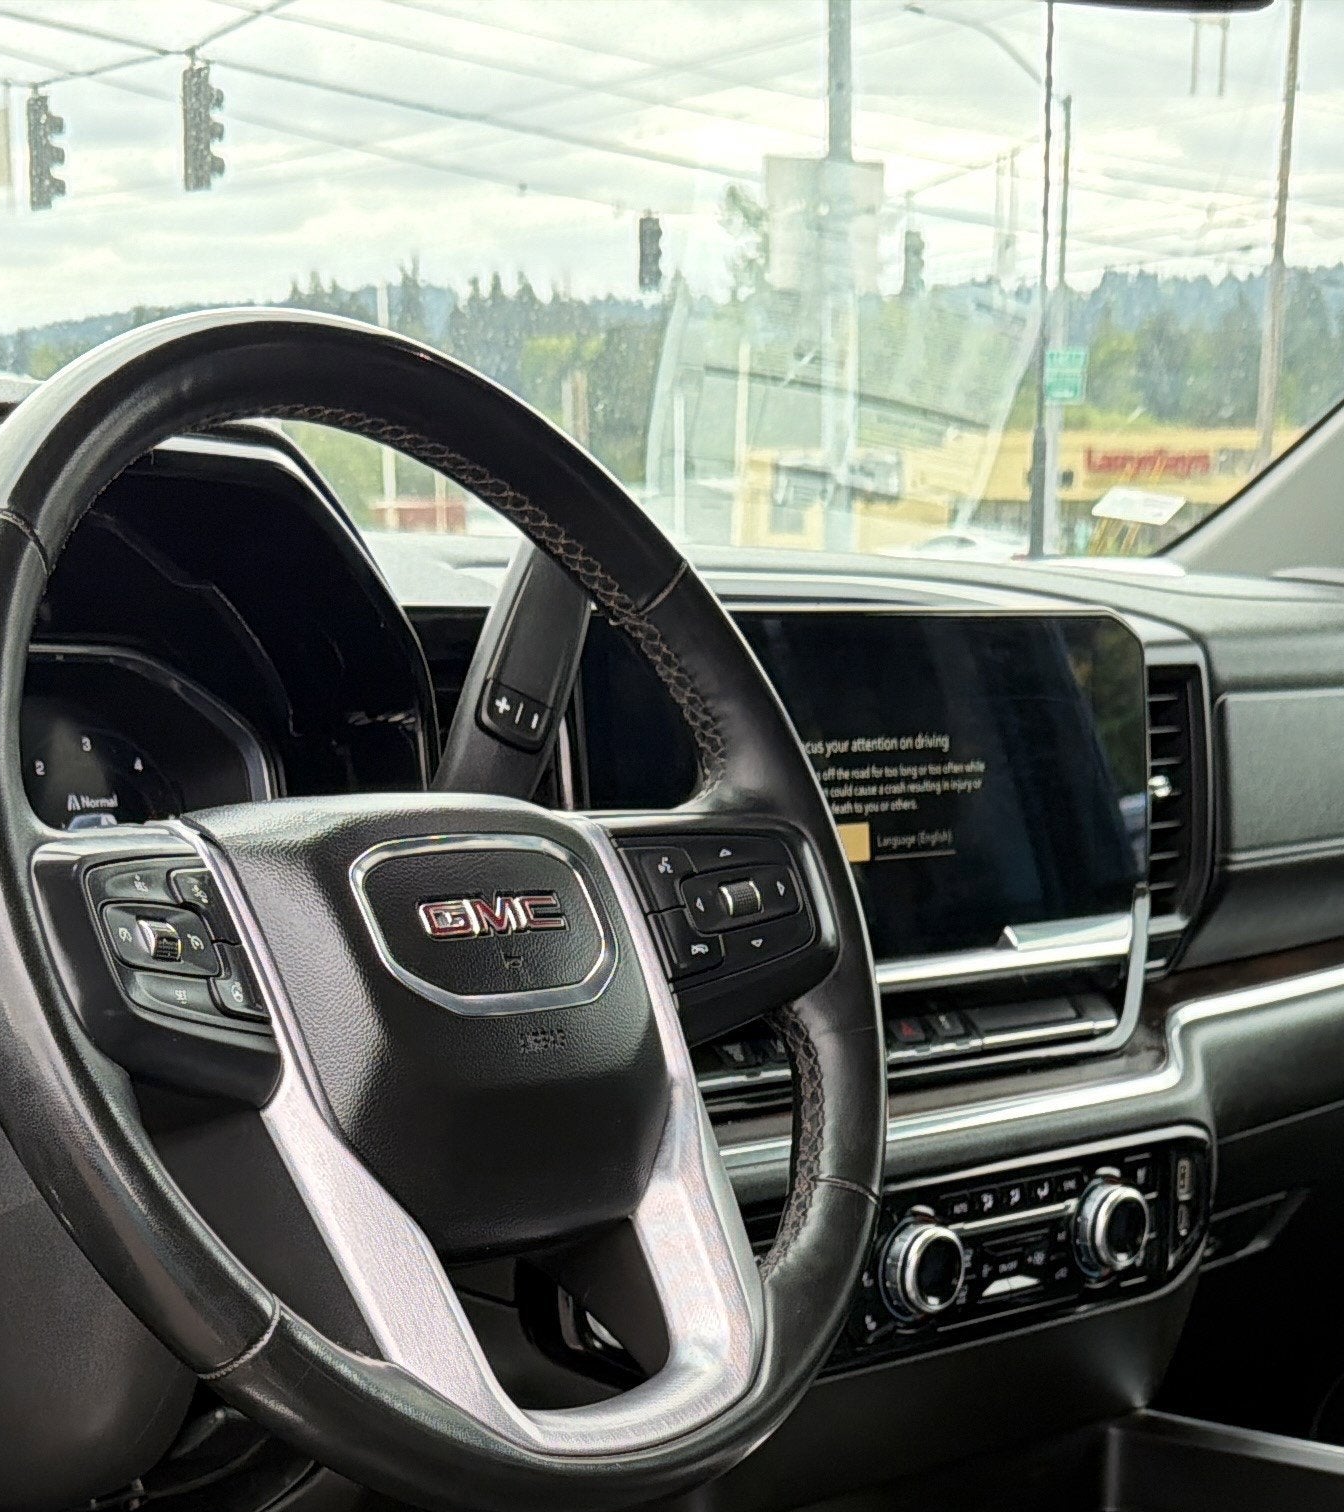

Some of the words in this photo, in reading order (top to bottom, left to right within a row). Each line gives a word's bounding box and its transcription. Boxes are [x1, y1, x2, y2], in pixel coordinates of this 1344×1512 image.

[81, 736, 91, 751] 3
[805, 740, 824, 754] cus
[825, 740, 849, 758] your
[851, 737, 898, 752] attention
[900, 737, 913, 750] on
[915, 733, 949, 752] driving
[35, 761, 45, 776] 2
[134, 757, 143, 771] 4
[80, 793, 119, 809] Normal
[418, 895, 567, 939] GMC
